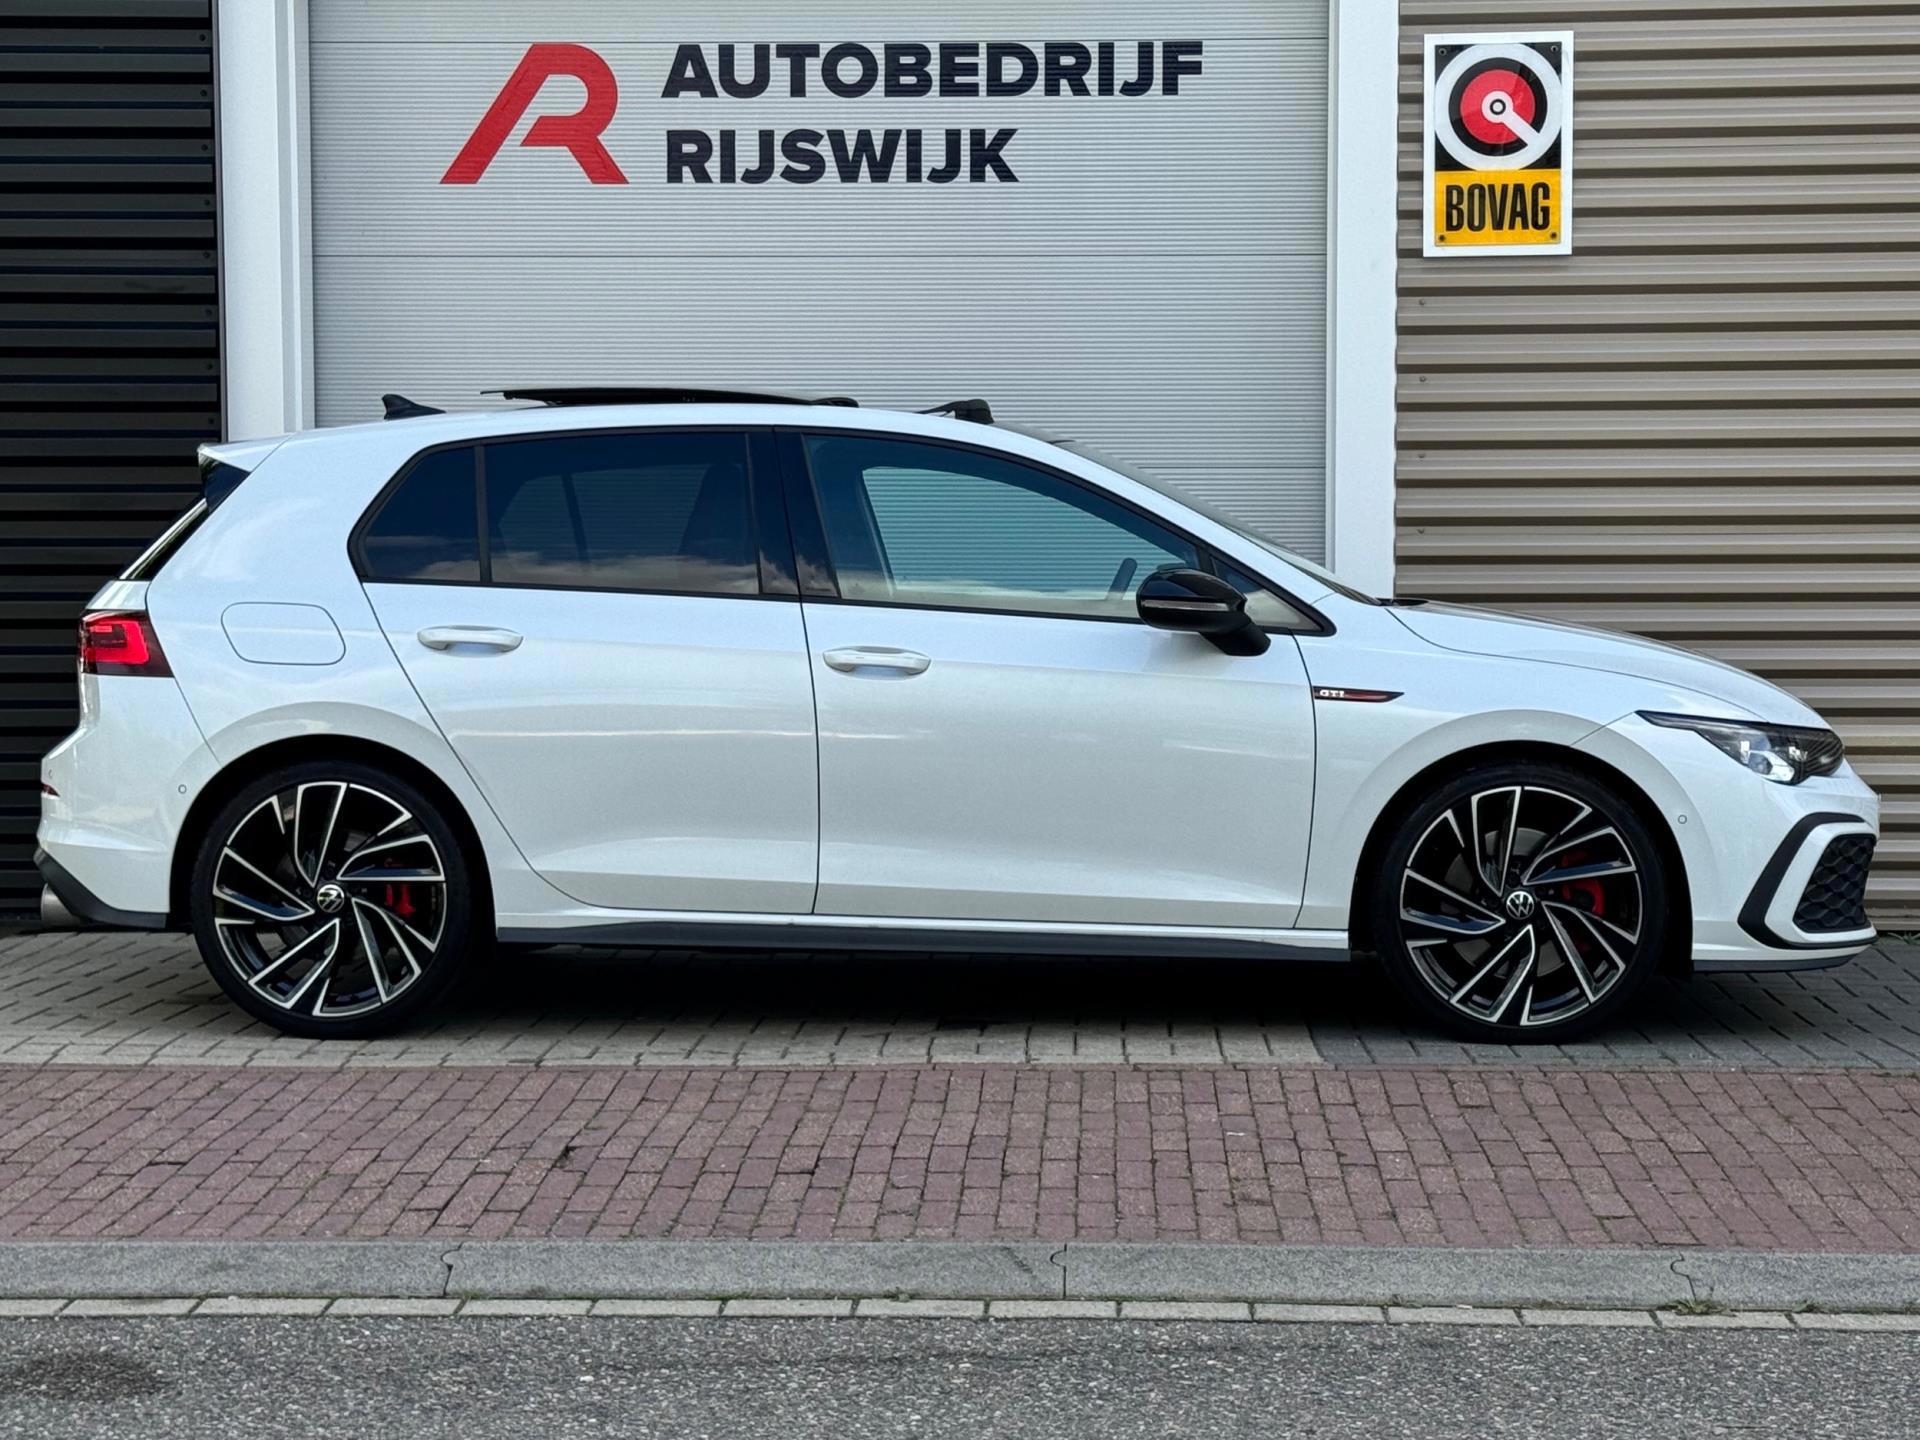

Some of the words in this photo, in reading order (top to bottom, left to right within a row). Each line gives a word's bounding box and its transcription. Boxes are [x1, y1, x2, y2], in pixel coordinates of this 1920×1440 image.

[660, 41, 1203, 99] AUTOBEDRIJF
[666, 128, 1019, 185] RIJSWIJK
[1445, 182, 1551, 232] BOVAG
[1319, 689, 1345, 698] GTI
